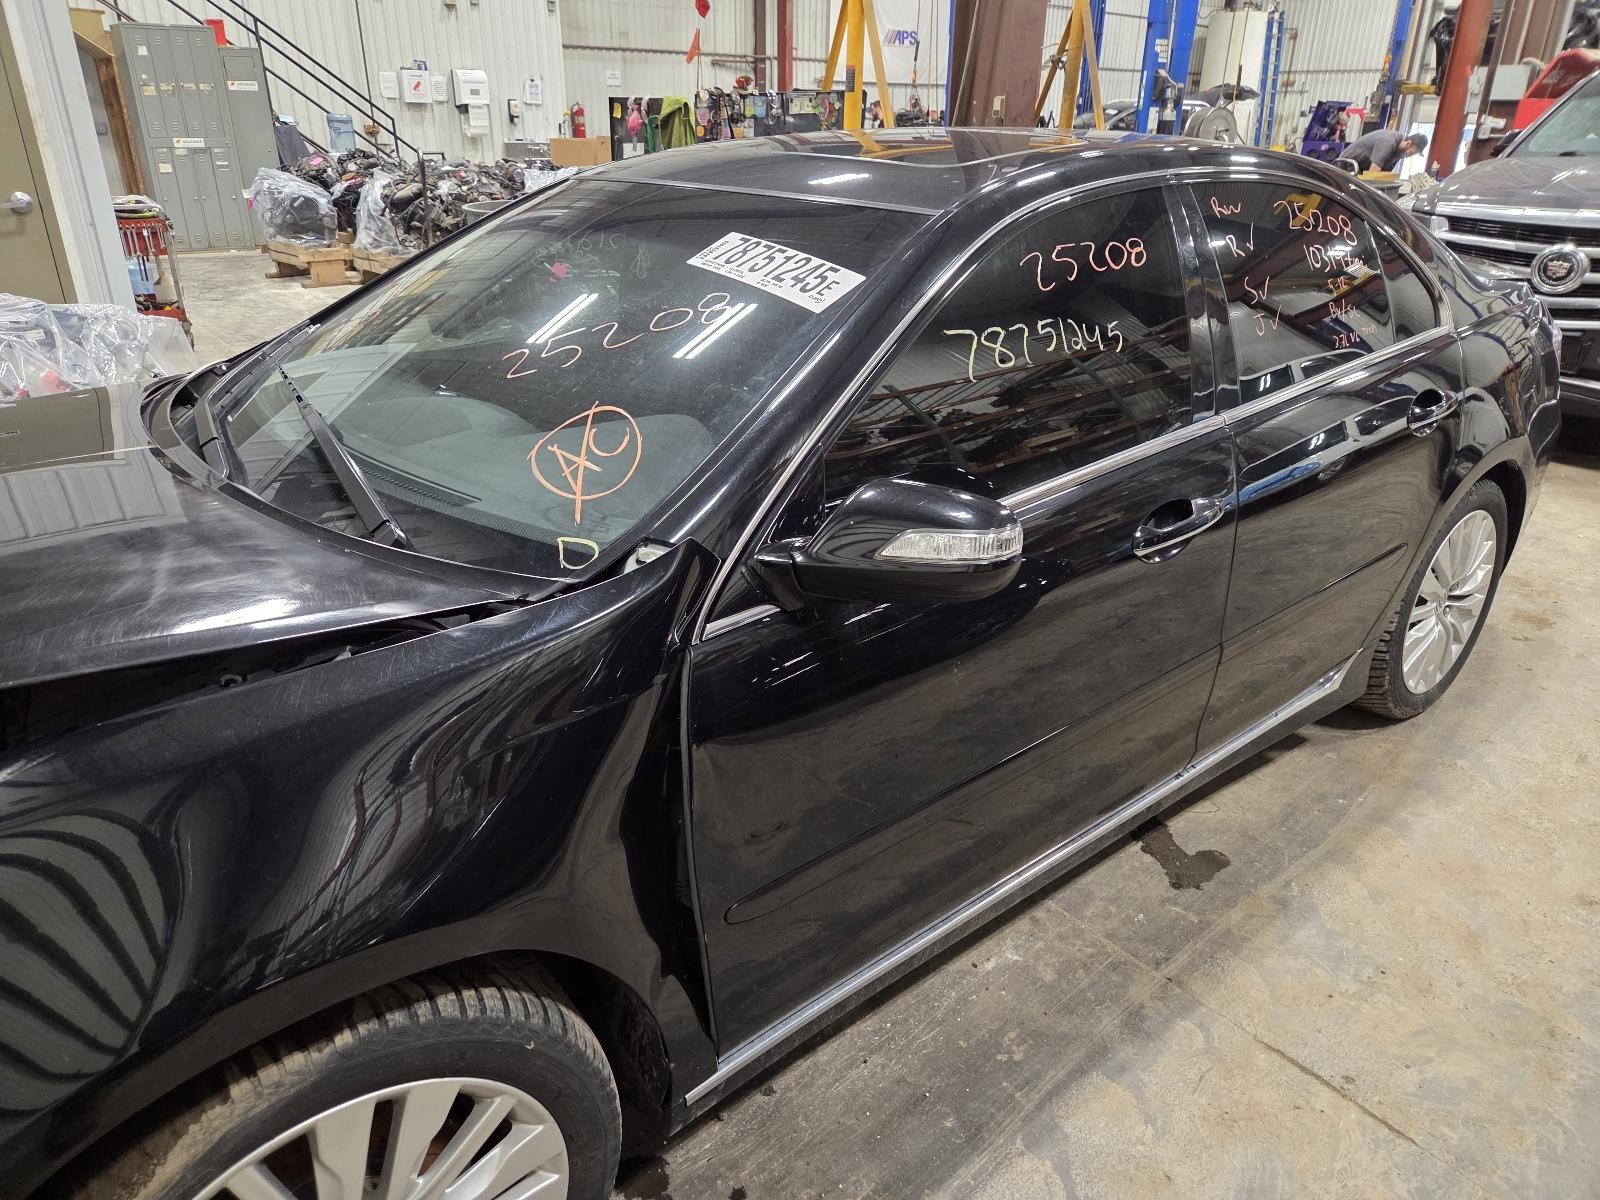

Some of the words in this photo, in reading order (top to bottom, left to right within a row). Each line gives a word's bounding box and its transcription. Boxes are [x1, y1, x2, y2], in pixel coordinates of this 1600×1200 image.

[892, 30, 917, 45] APS
[1274, 201, 1357, 245] 25208
[713, 237, 841, 293] 78751245
[1020, 238, 1146, 291] 25208
[502, 292, 732, 378] 25208
[942, 316, 1123, 382] 78751245
